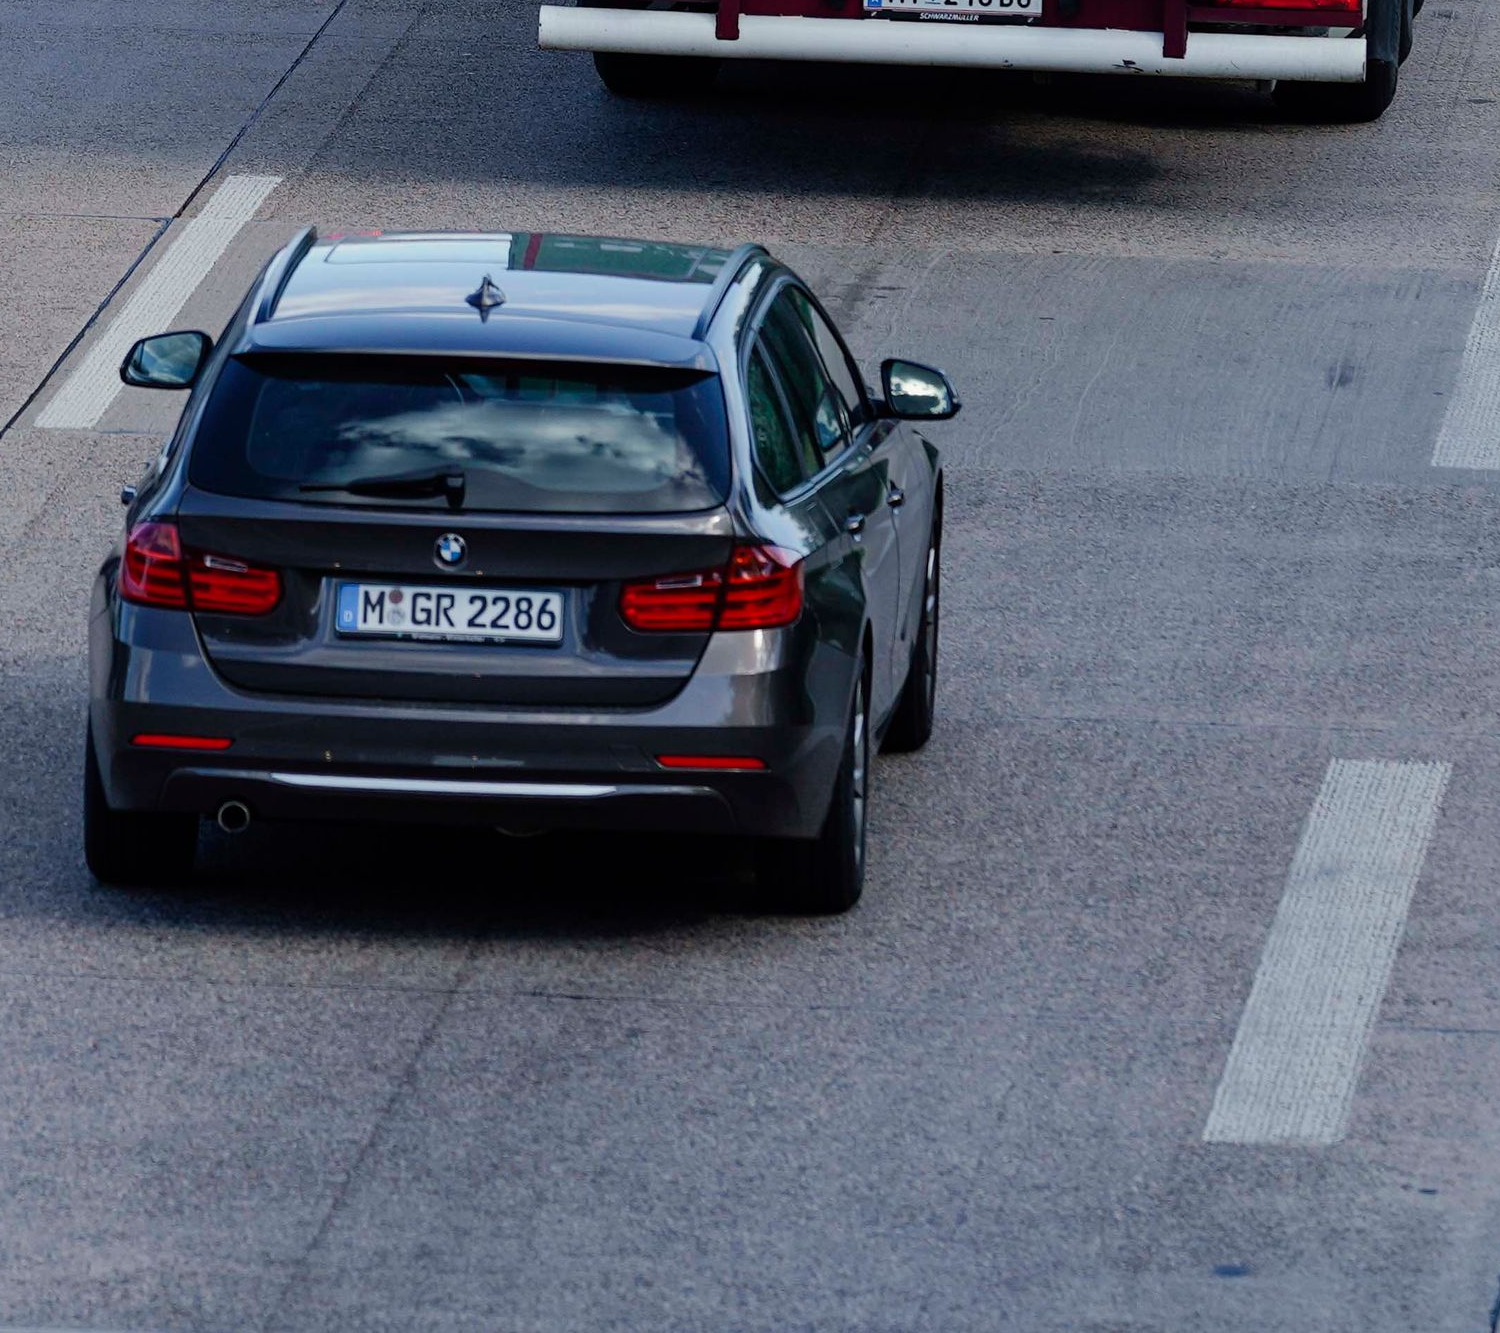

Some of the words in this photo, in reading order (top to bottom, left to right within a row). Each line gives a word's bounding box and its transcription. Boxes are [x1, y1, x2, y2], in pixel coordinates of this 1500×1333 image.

[919, 12, 980, 23] SCHWARZMÜLLER
[362, 590, 386, 625] M
[410, 592, 455, 628] GR
[467, 595, 557, 631] 2286
